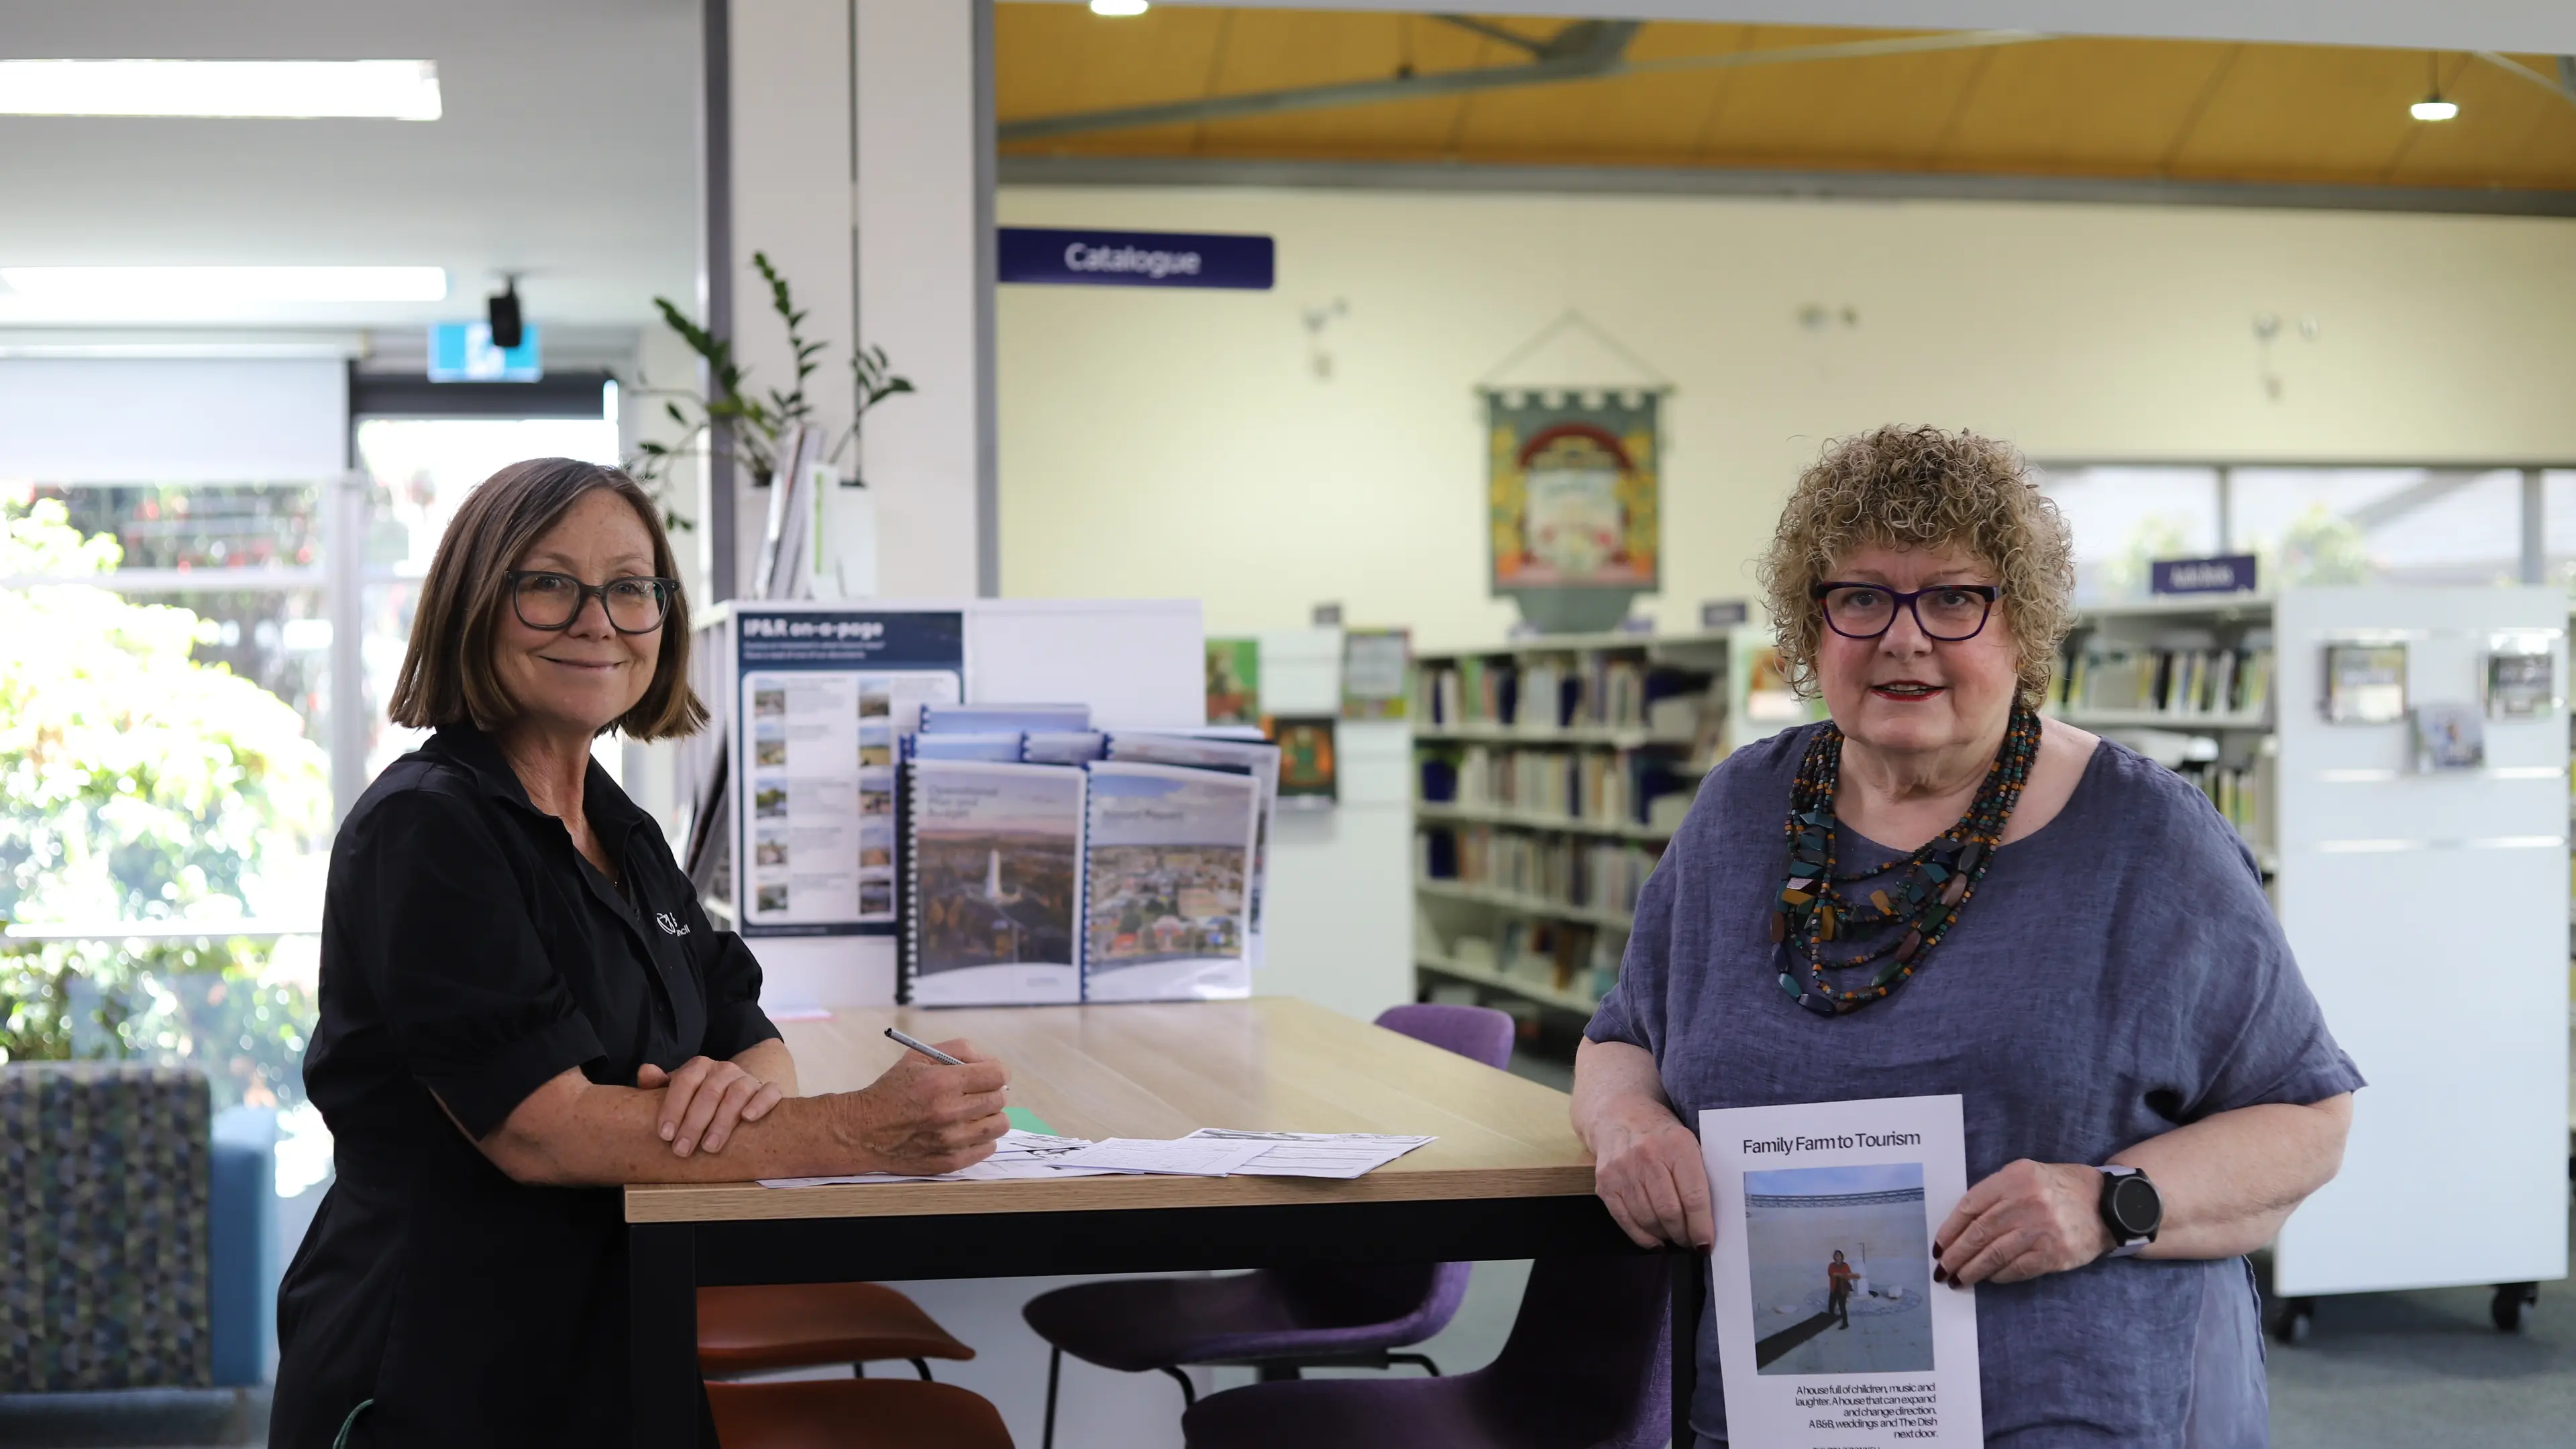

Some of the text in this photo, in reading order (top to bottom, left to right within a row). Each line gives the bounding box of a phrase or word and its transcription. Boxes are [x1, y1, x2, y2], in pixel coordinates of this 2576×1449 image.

[1064, 242, 1201, 278] Catalogue
[743, 619, 883, 641] IP&R on-a-page
[1743, 1131, 1921, 1155] Family Farm to Tourism
[1796, 1382, 1935, 1395] A house full of children, music and
[1795, 1394, 1936, 1408] laughter. A house that can expand
[1843, 1406, 1937, 1418] and change direction.
[1835, 1419, 1878, 1430] weddings
[1880, 1418, 1898, 1428] and
[1898, 1417, 1917, 1427] The
[1918, 1417, 1937, 1426] Dish
[1894, 1429, 1939, 1438] next door.
